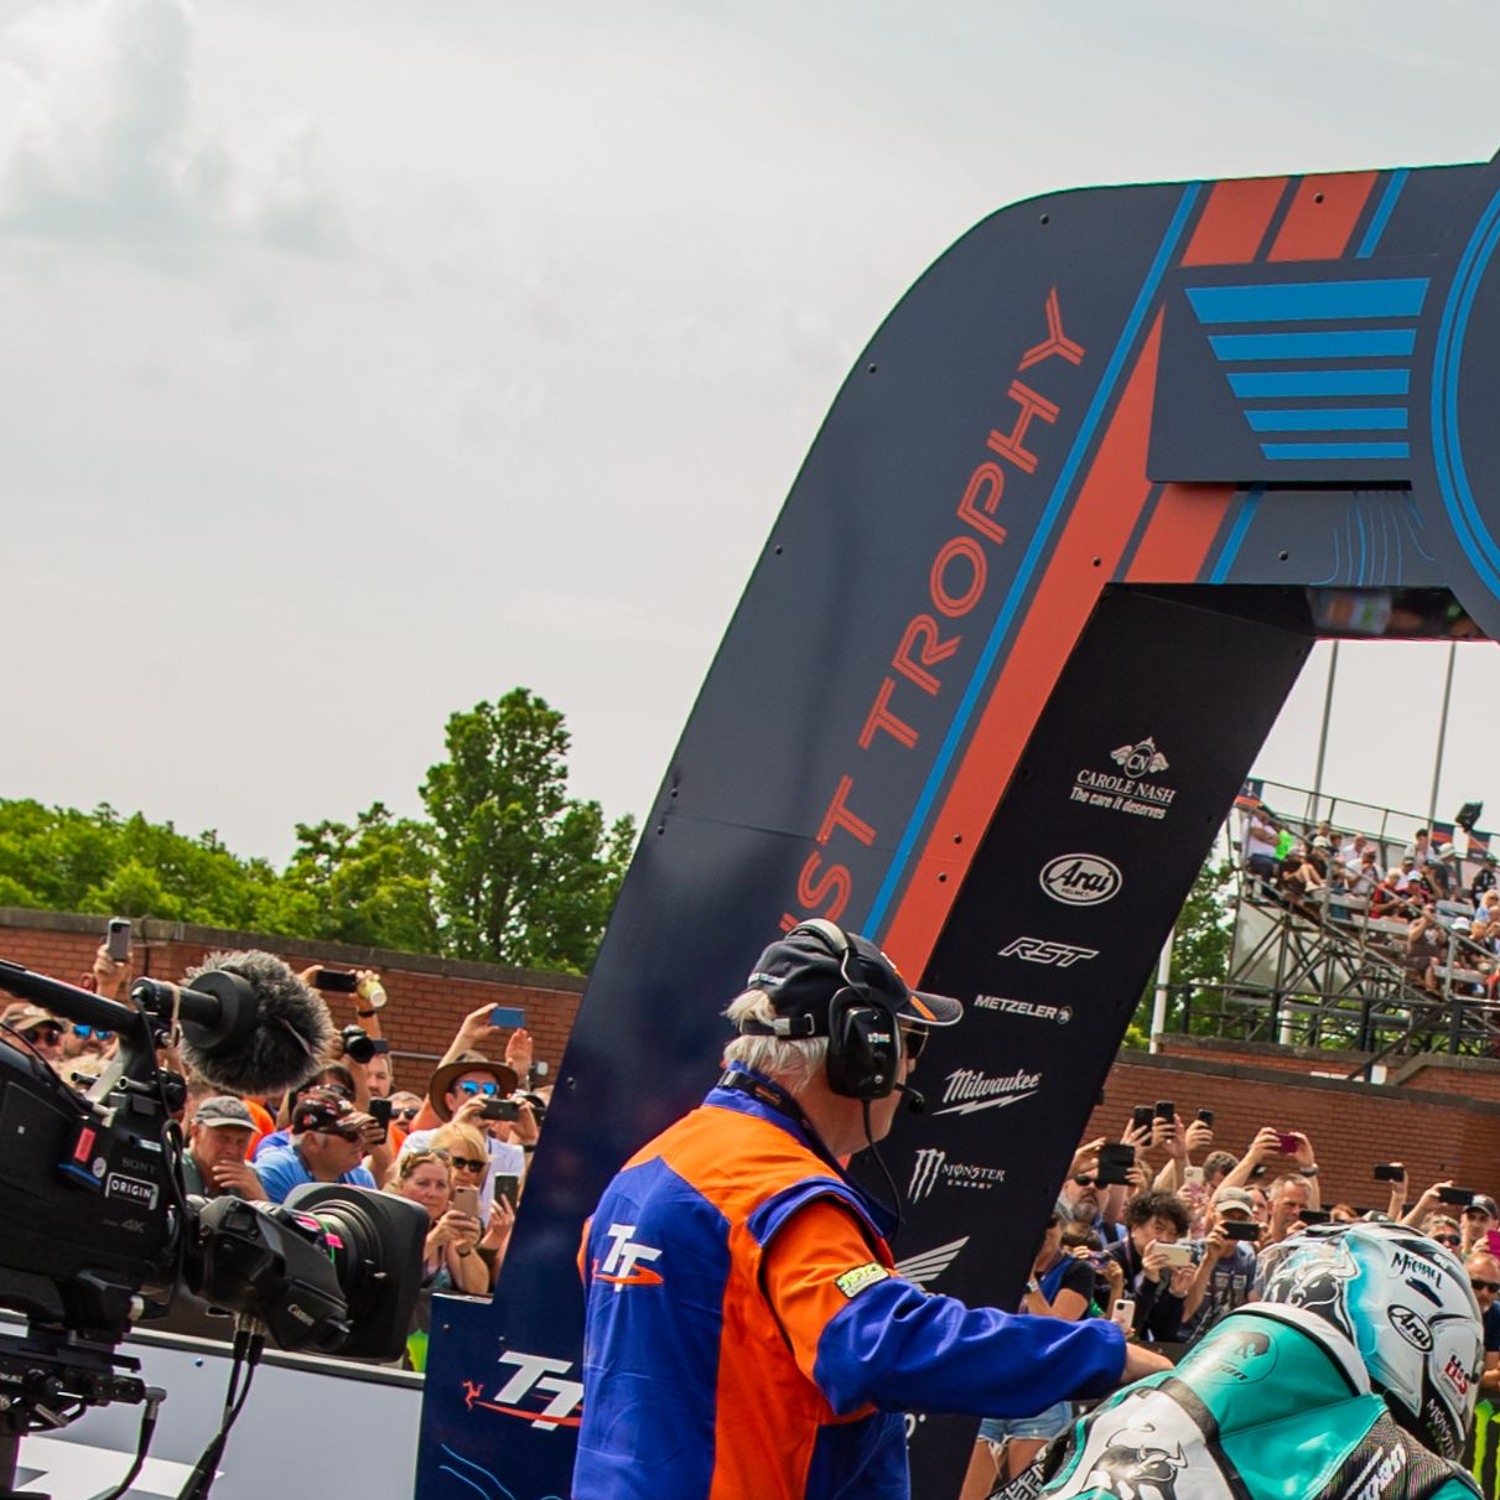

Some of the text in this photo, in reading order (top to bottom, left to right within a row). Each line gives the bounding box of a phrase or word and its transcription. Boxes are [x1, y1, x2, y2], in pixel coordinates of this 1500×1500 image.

[858, 286, 1085, 749] TROPHY
[1077, 769, 1176, 803] CAROLE NASH
[1070, 786, 1168, 820] The care it deserves
[1045, 860, 1114, 892] Arai
[998, 936, 1100, 967] RST
[974, 995, 1059, 1020] METZELER
[942, 1068, 1042, 1104] Milwaukee
[111, 1180, 152, 1198] ORIGIN
[941, 1163, 1006, 1182] MONSTER
[1391, 1309, 1431, 1347] Arai
